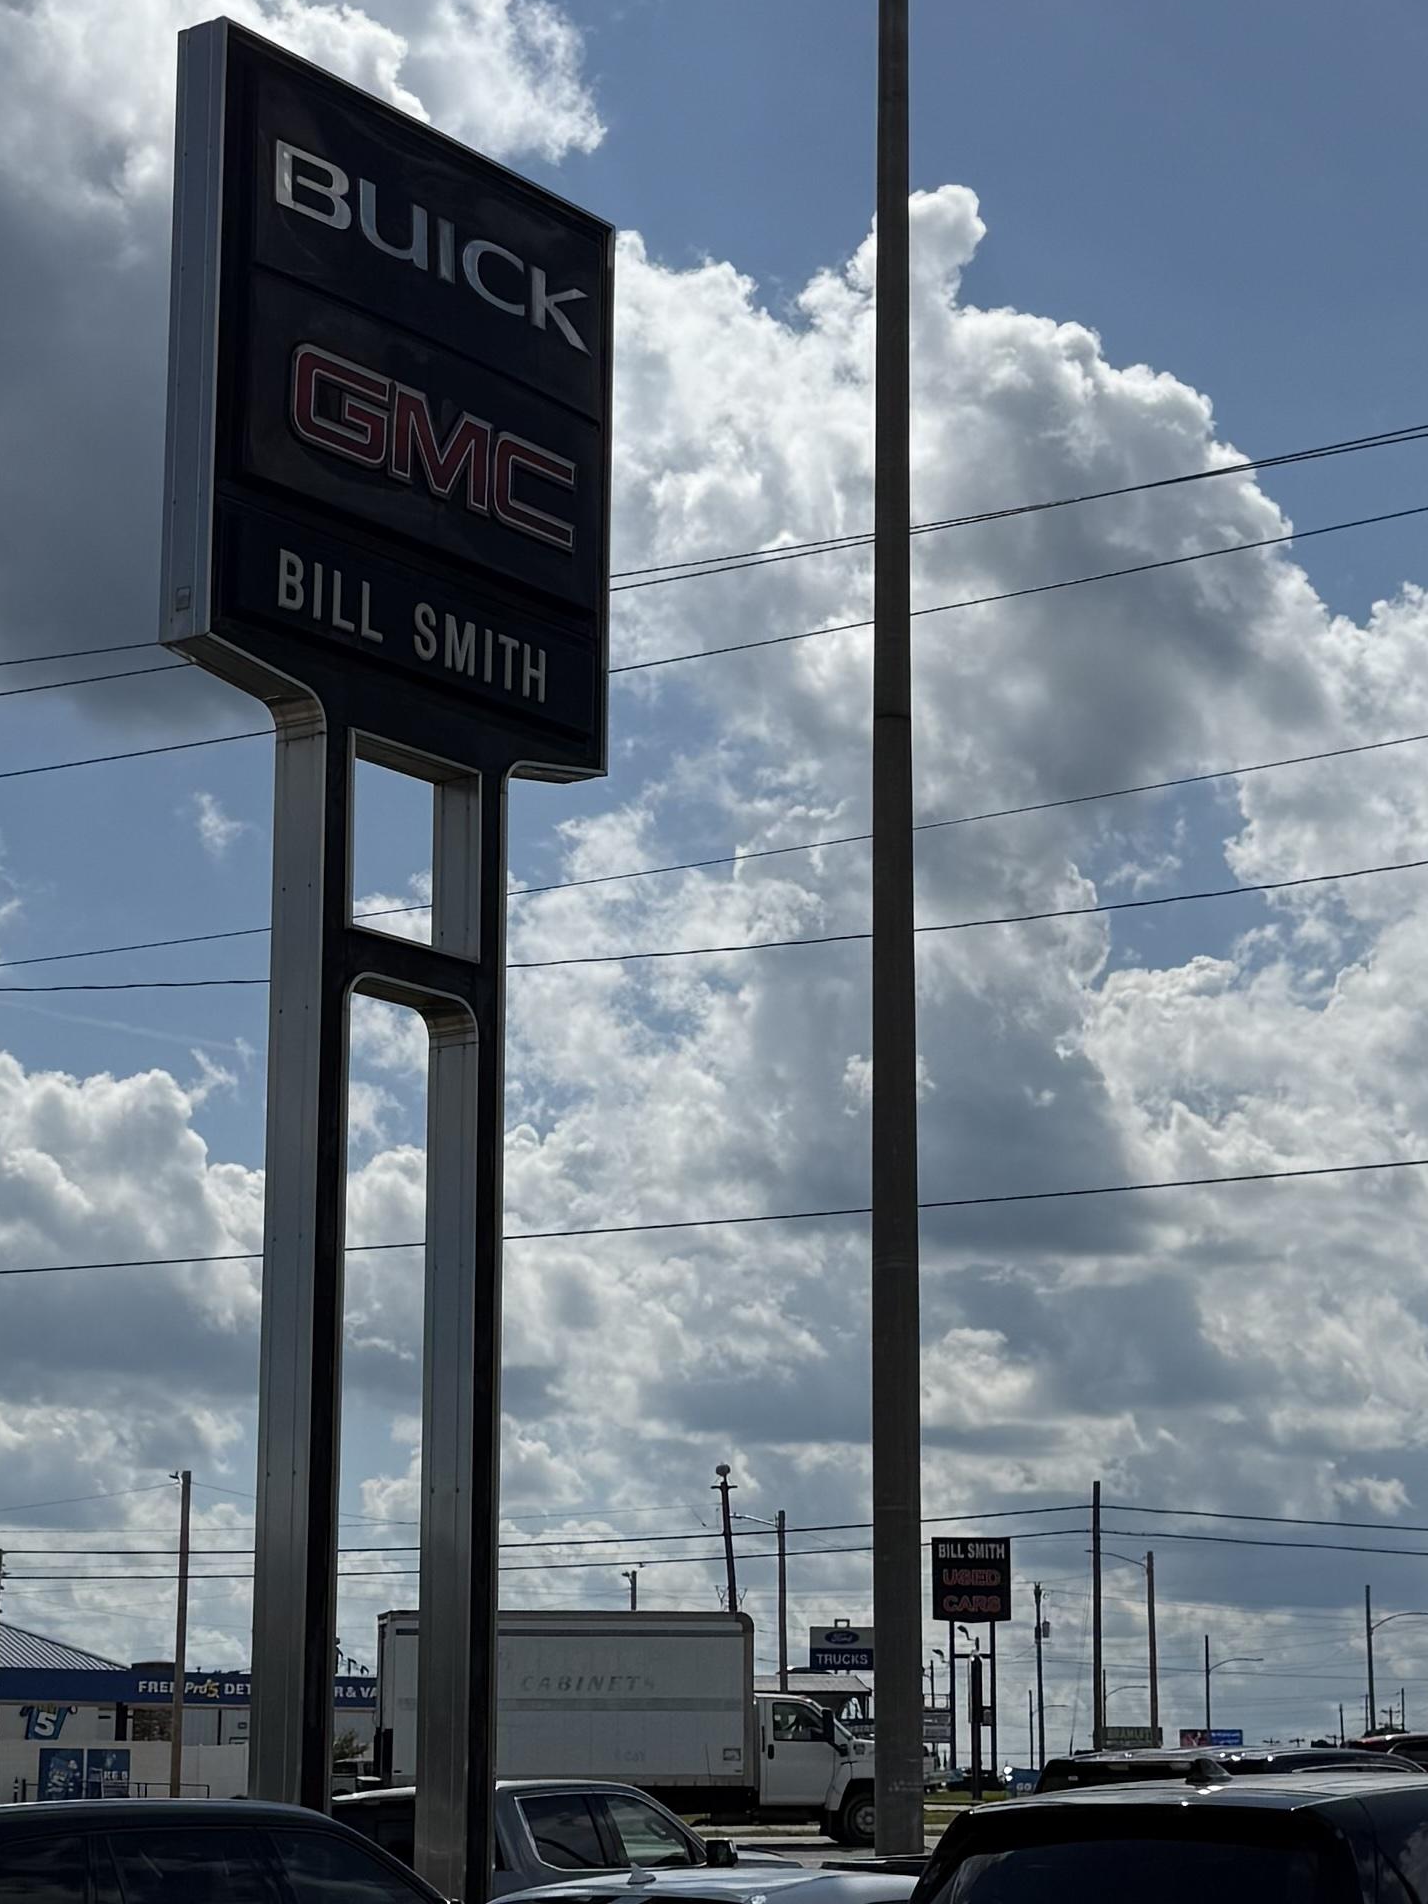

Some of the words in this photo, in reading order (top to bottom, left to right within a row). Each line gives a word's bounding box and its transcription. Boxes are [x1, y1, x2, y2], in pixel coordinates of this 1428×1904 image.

[274, 139, 592, 357] BUICK
[289, 342, 576, 551] GMC
[278, 548, 384, 645] BILL
[414, 601, 547, 703] SMITH
[938, 1543, 965, 1559] BILL
[967, 1543, 1005, 1560] SMITH
[942, 1568, 1001, 1586] USED
[942, 1595, 1001, 1613] CARS
[815, 1653, 868, 1665] TRUCKS
[34, 1711, 58, 1737] 5
